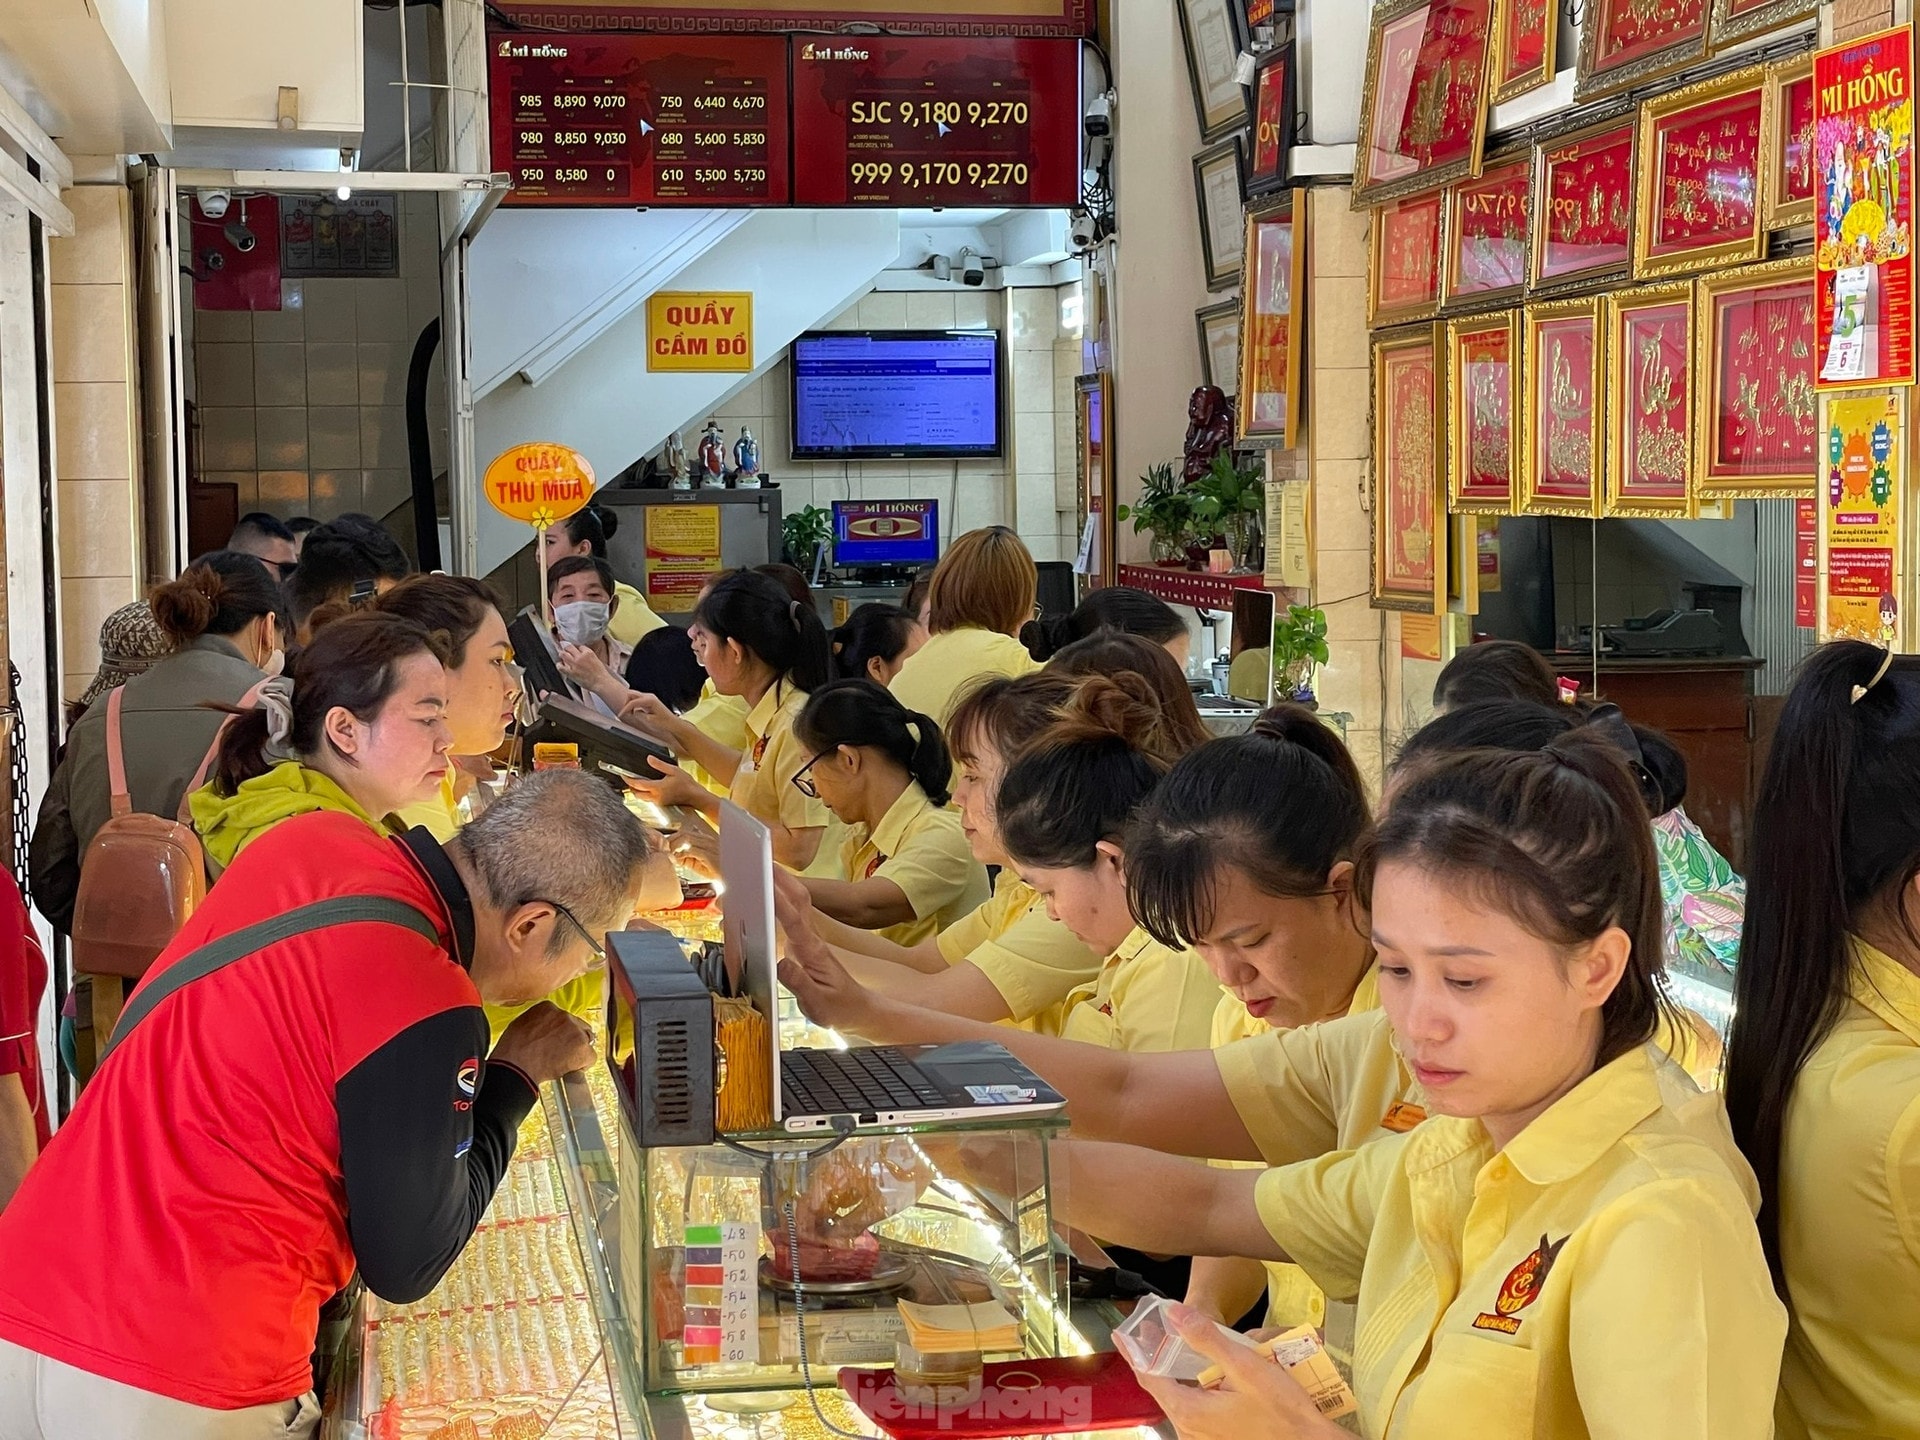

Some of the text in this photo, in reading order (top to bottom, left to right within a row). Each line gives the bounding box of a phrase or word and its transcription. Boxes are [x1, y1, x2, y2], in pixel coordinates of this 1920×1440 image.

[519, 95, 626, 109] 985 8,890 9,070
[660, 96, 765, 110] 750 6,440 6,670
[851, 101, 1028, 128] SJC 9,180 9,270
[520, 131, 627, 146] 980 8,850 9,030
[661, 132, 765, 147] 680 5,600 5,830
[521, 168, 615, 183] 950 8,580 0
[661, 169, 766, 183] 610 5,500 5,730
[851, 162, 1028, 189] 999 9,170 9,270
[666, 300, 735, 327] QUẦY
[1841, 294, 1857, 338] 5
[655, 331, 747, 355] CẦM ĐỒ
[1839, 350, 1849, 369] 6
[496, 478, 584, 504] THU MUA
[453, 1100, 473, 1112] TO
